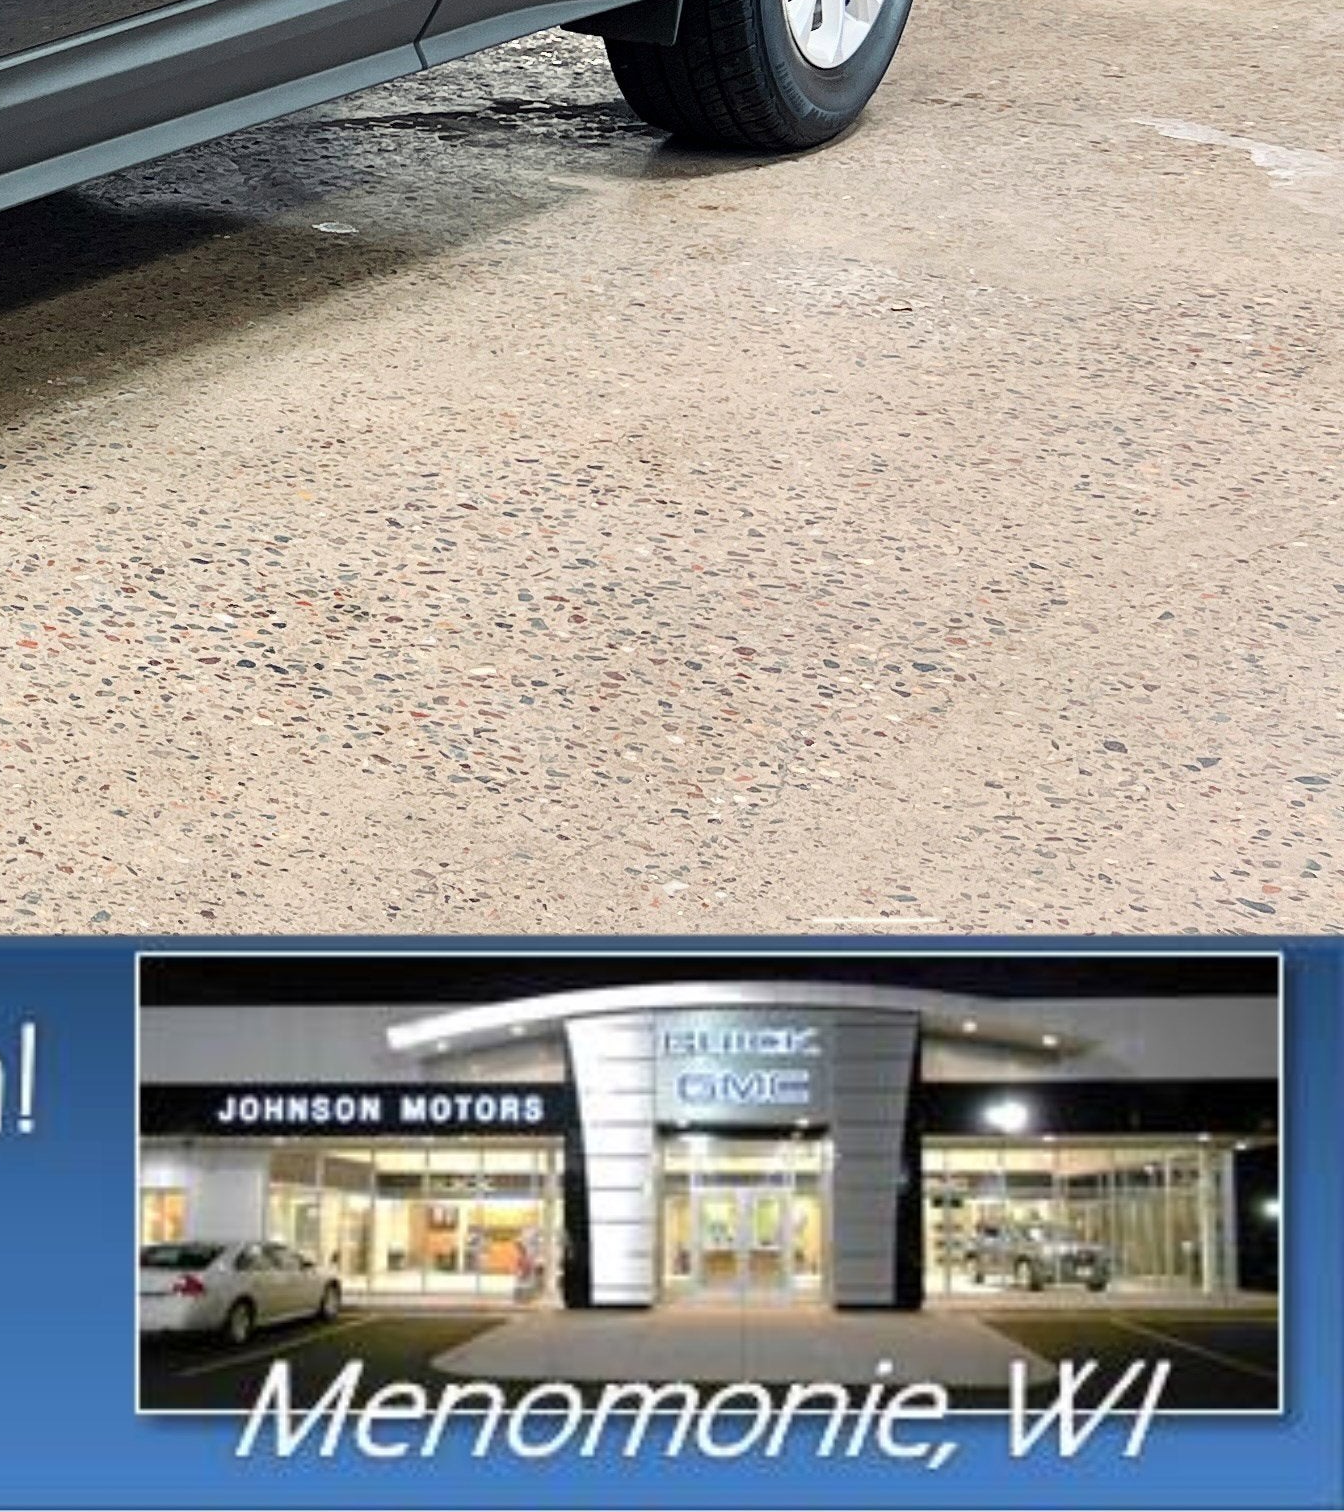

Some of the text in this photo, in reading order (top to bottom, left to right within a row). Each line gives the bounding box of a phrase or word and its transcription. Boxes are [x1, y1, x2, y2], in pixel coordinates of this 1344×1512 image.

[675, 1068, 811, 1106] GMC
[217, 1094, 545, 1124] JOHNSON MOTORS
